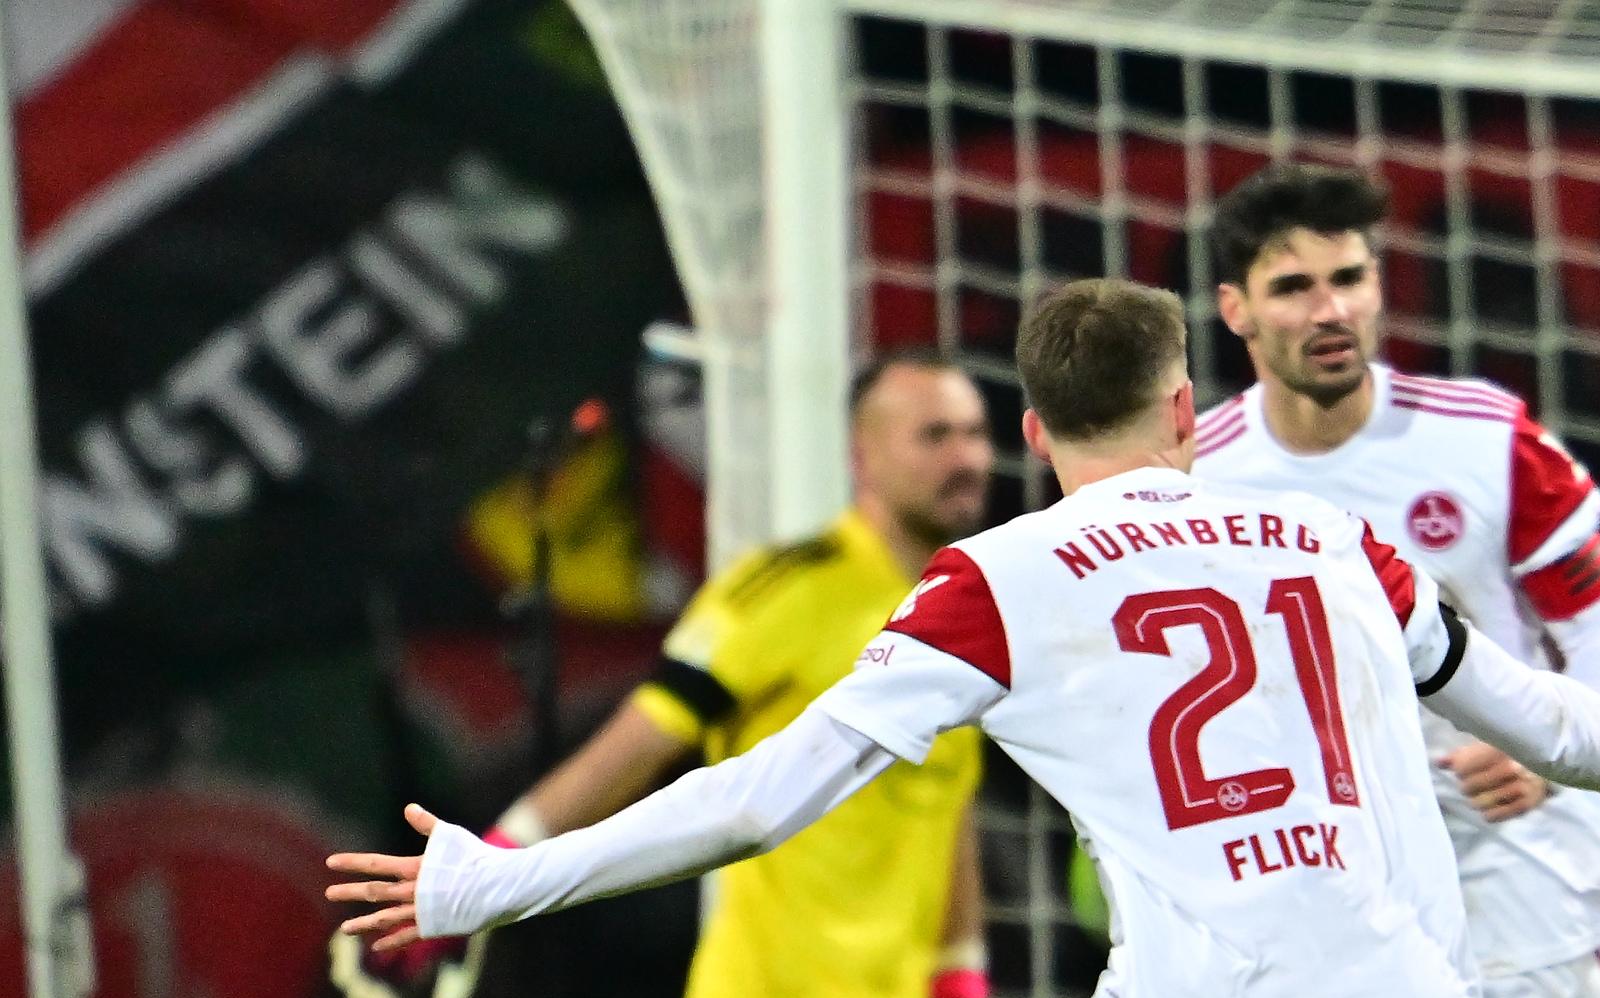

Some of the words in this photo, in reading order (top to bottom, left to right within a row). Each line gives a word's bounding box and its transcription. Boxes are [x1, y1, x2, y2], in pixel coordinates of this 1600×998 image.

[1053, 512, 1321, 580] NÜRNBERG
[1112, 575, 1360, 831] 21
[1222, 823, 1347, 882] FLICK
